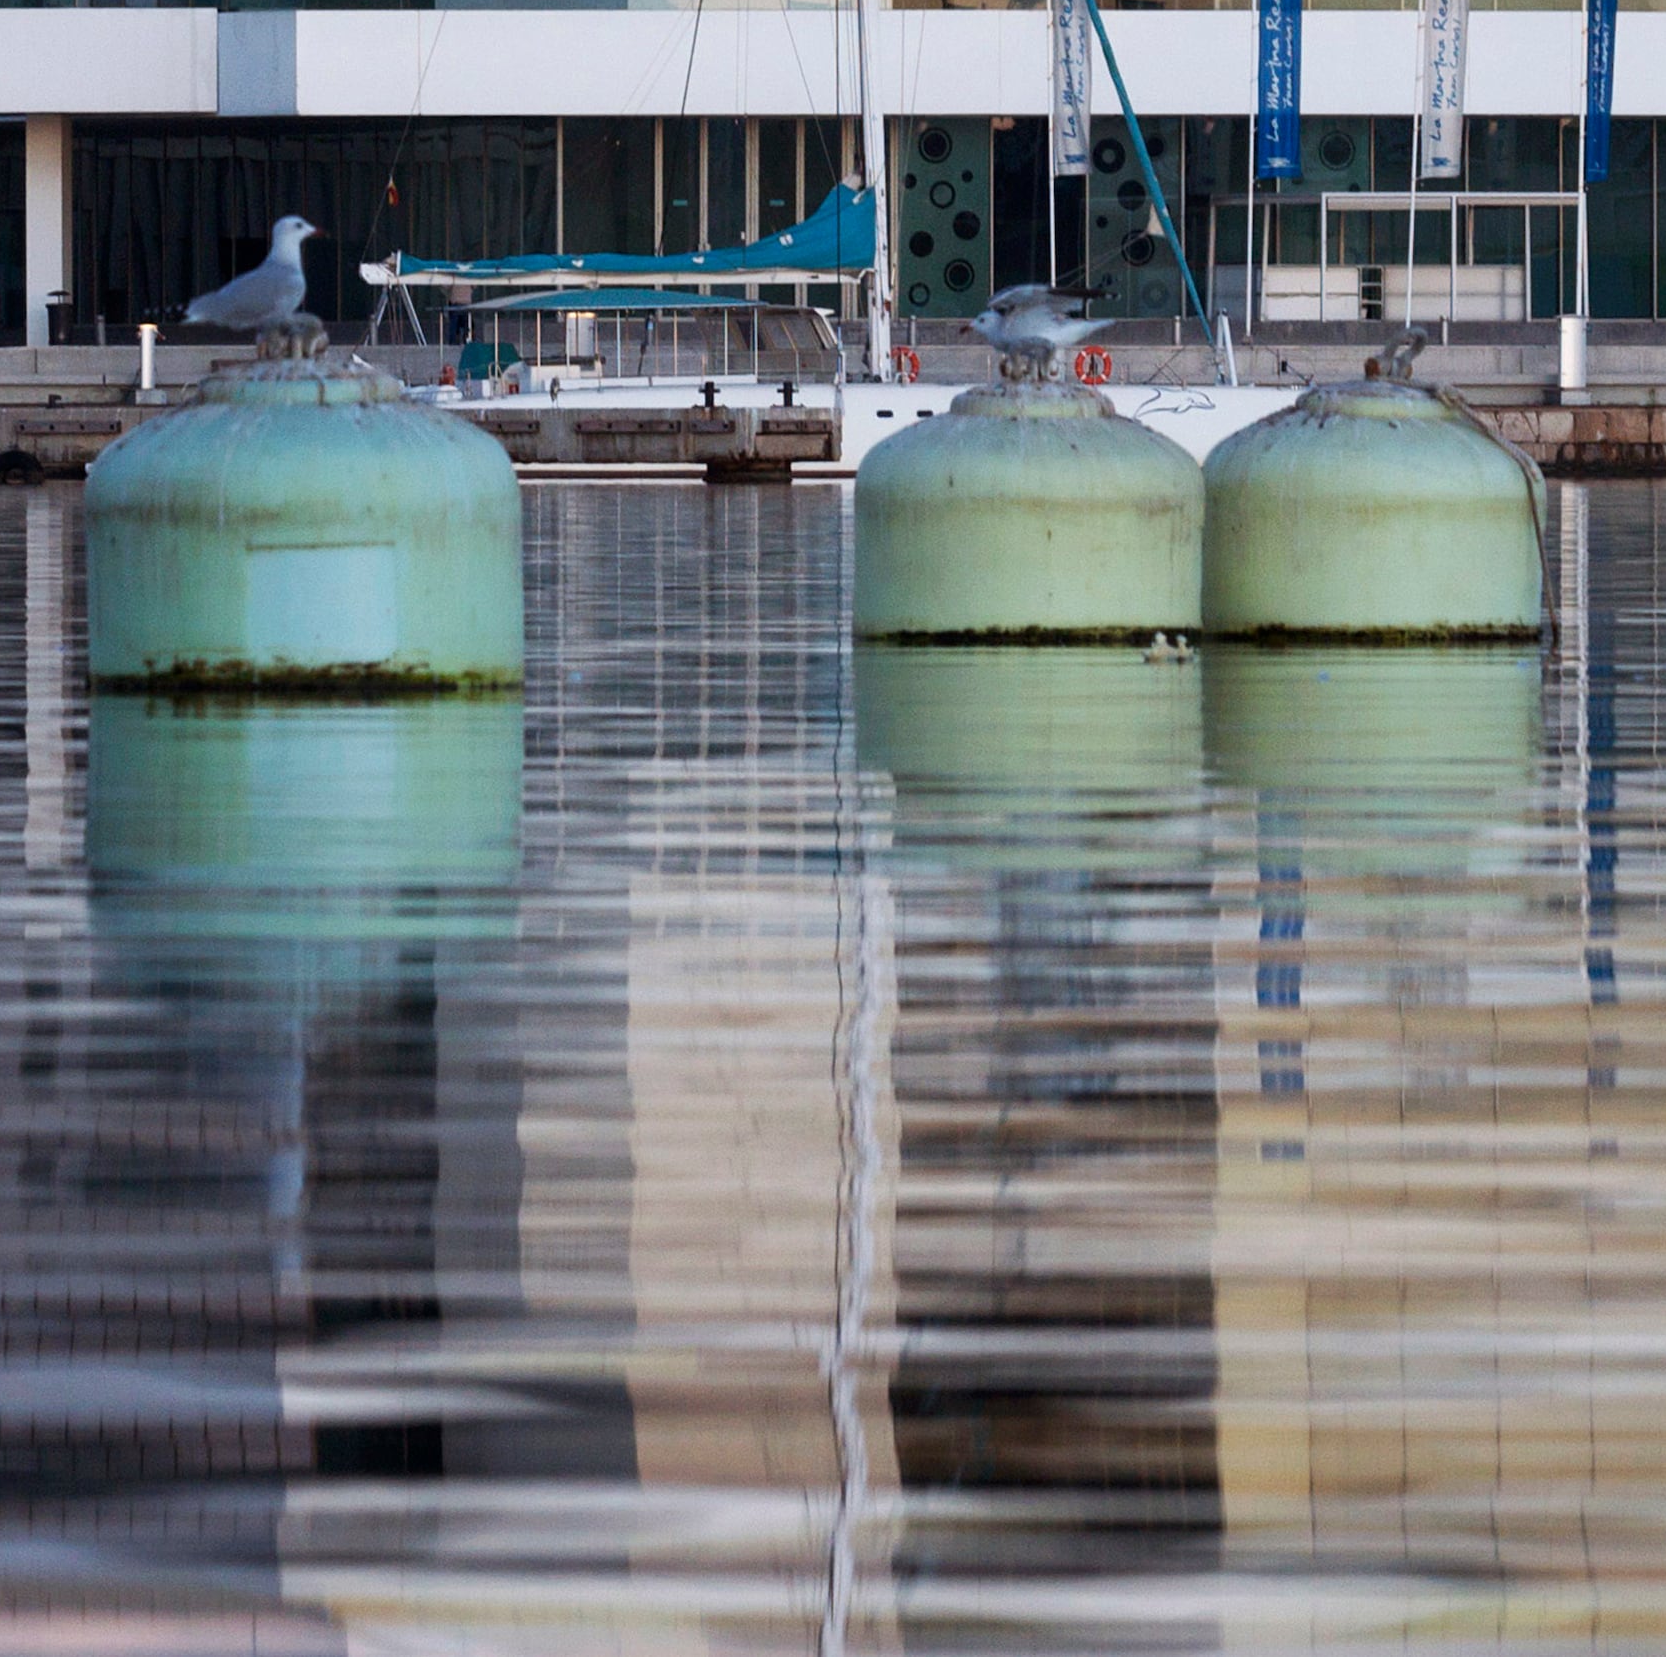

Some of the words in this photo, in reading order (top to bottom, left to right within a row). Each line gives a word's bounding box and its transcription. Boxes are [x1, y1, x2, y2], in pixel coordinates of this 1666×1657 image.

[1266, 38, 1281, 110] Marina
[1284, 73, 1293, 108] Juan
[1432, 39, 1447, 109] Marina
[1448, 73, 1457, 108] Juan
[1063, 116, 1076, 138] La
[1267, 118, 1279, 142] La
[1431, 118, 1442, 141] La
